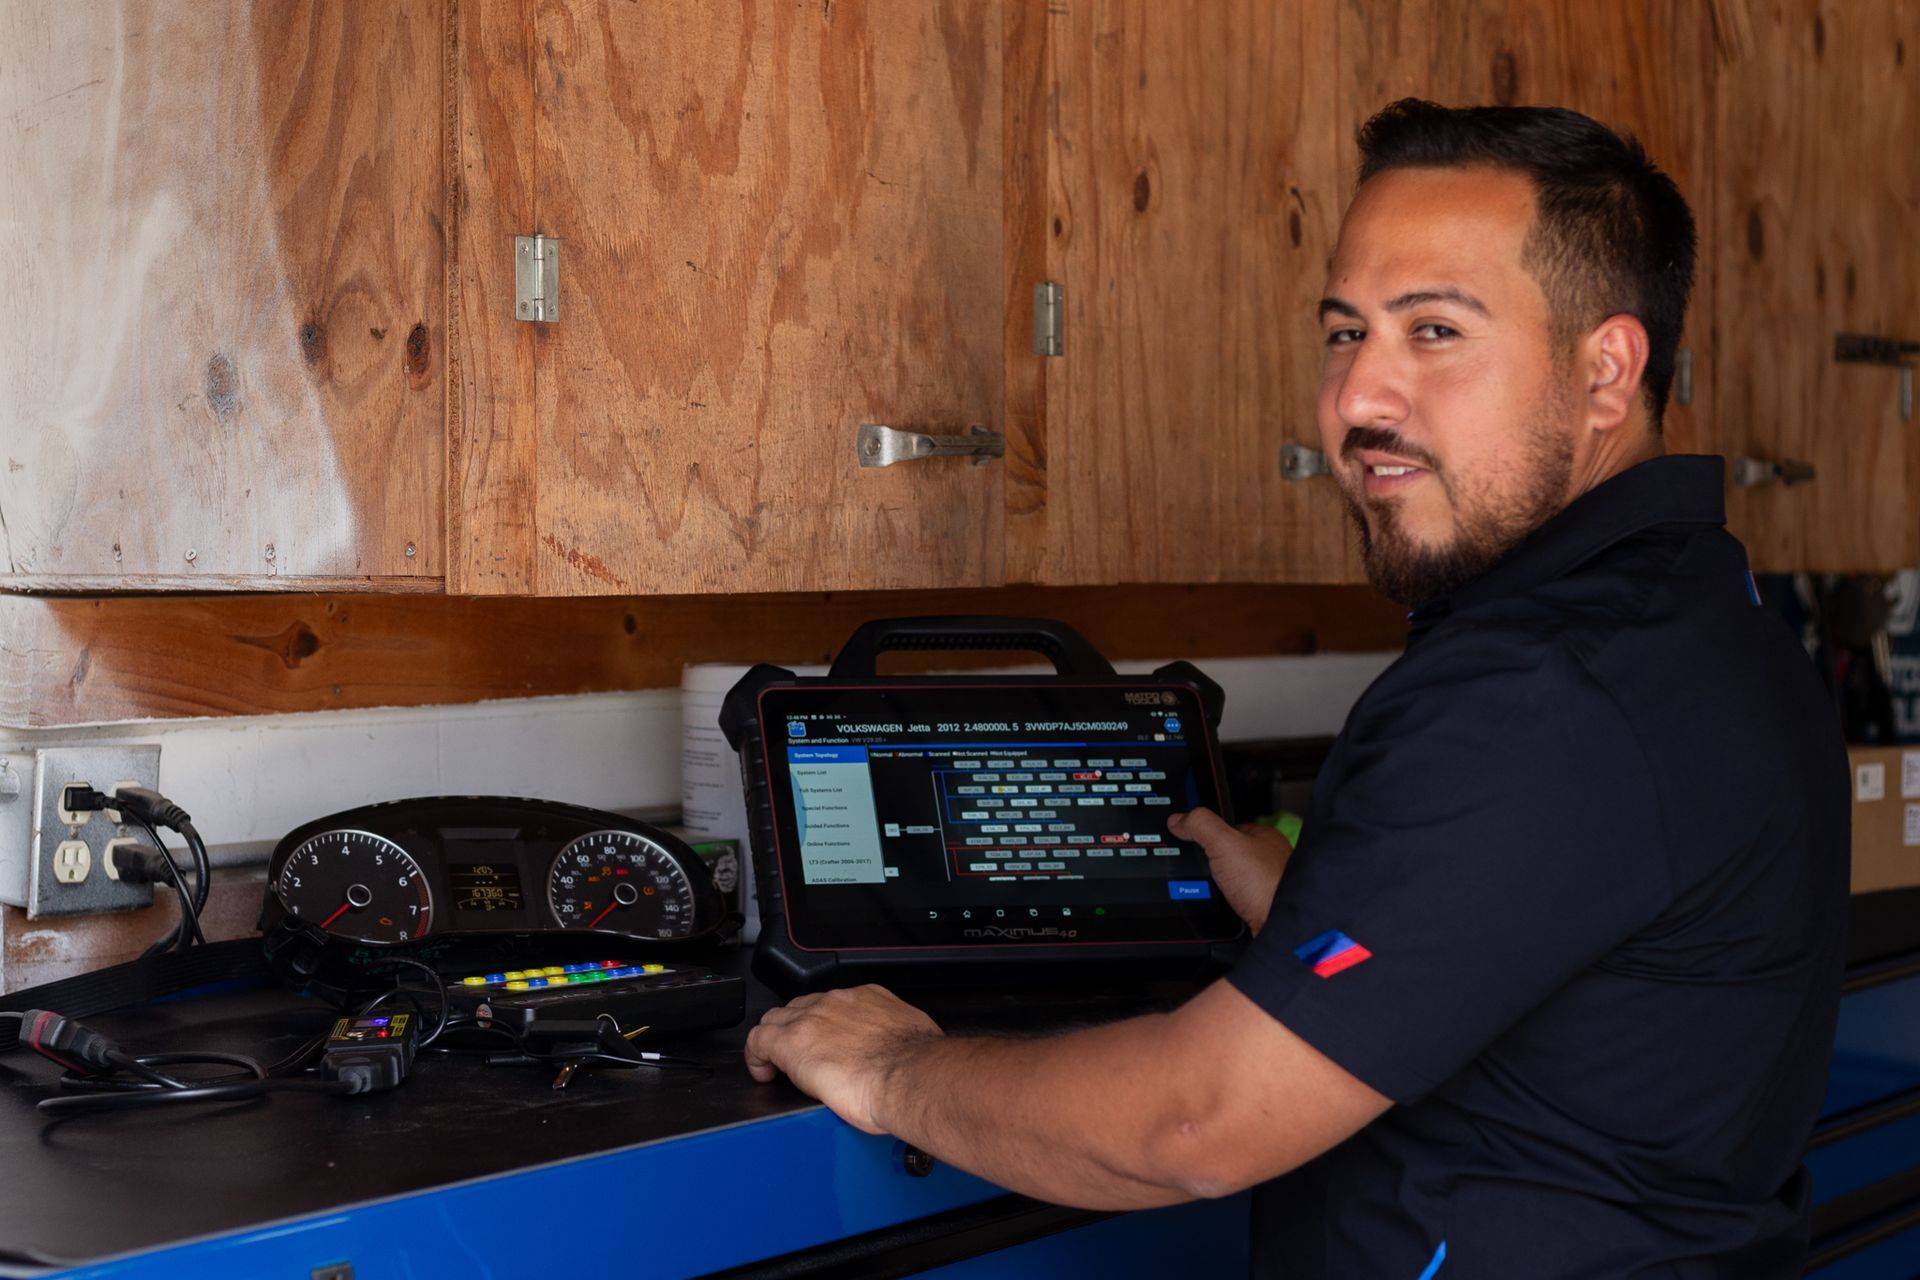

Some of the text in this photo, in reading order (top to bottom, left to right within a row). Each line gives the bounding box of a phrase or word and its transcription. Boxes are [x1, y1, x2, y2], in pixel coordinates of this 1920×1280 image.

[836, 724, 903, 733] VOLKSWAGEN
[907, 723, 931, 733] Jetta
[937, 723, 960, 732] 2012
[963, 722, 1011, 732] 2.480000L
[1012, 722, 1020, 731] 5
[342, 846, 350, 856] 4
[603, 846, 617, 855] 80
[311, 854, 319, 865] 3
[376, 855, 383, 865] 5
[576, 854, 590, 864] 60
[630, 854, 646, 863] 100
[294, 877, 302, 888] 2
[398, 876, 408, 887] 6
[560, 876, 574, 885] 40
[1179, 887, 1200, 895] Pause
[409, 905, 417, 916] 7
[561, 904, 575, 913] 20
[664, 904, 680, 913] 140
[399, 930, 408, 940] 8
